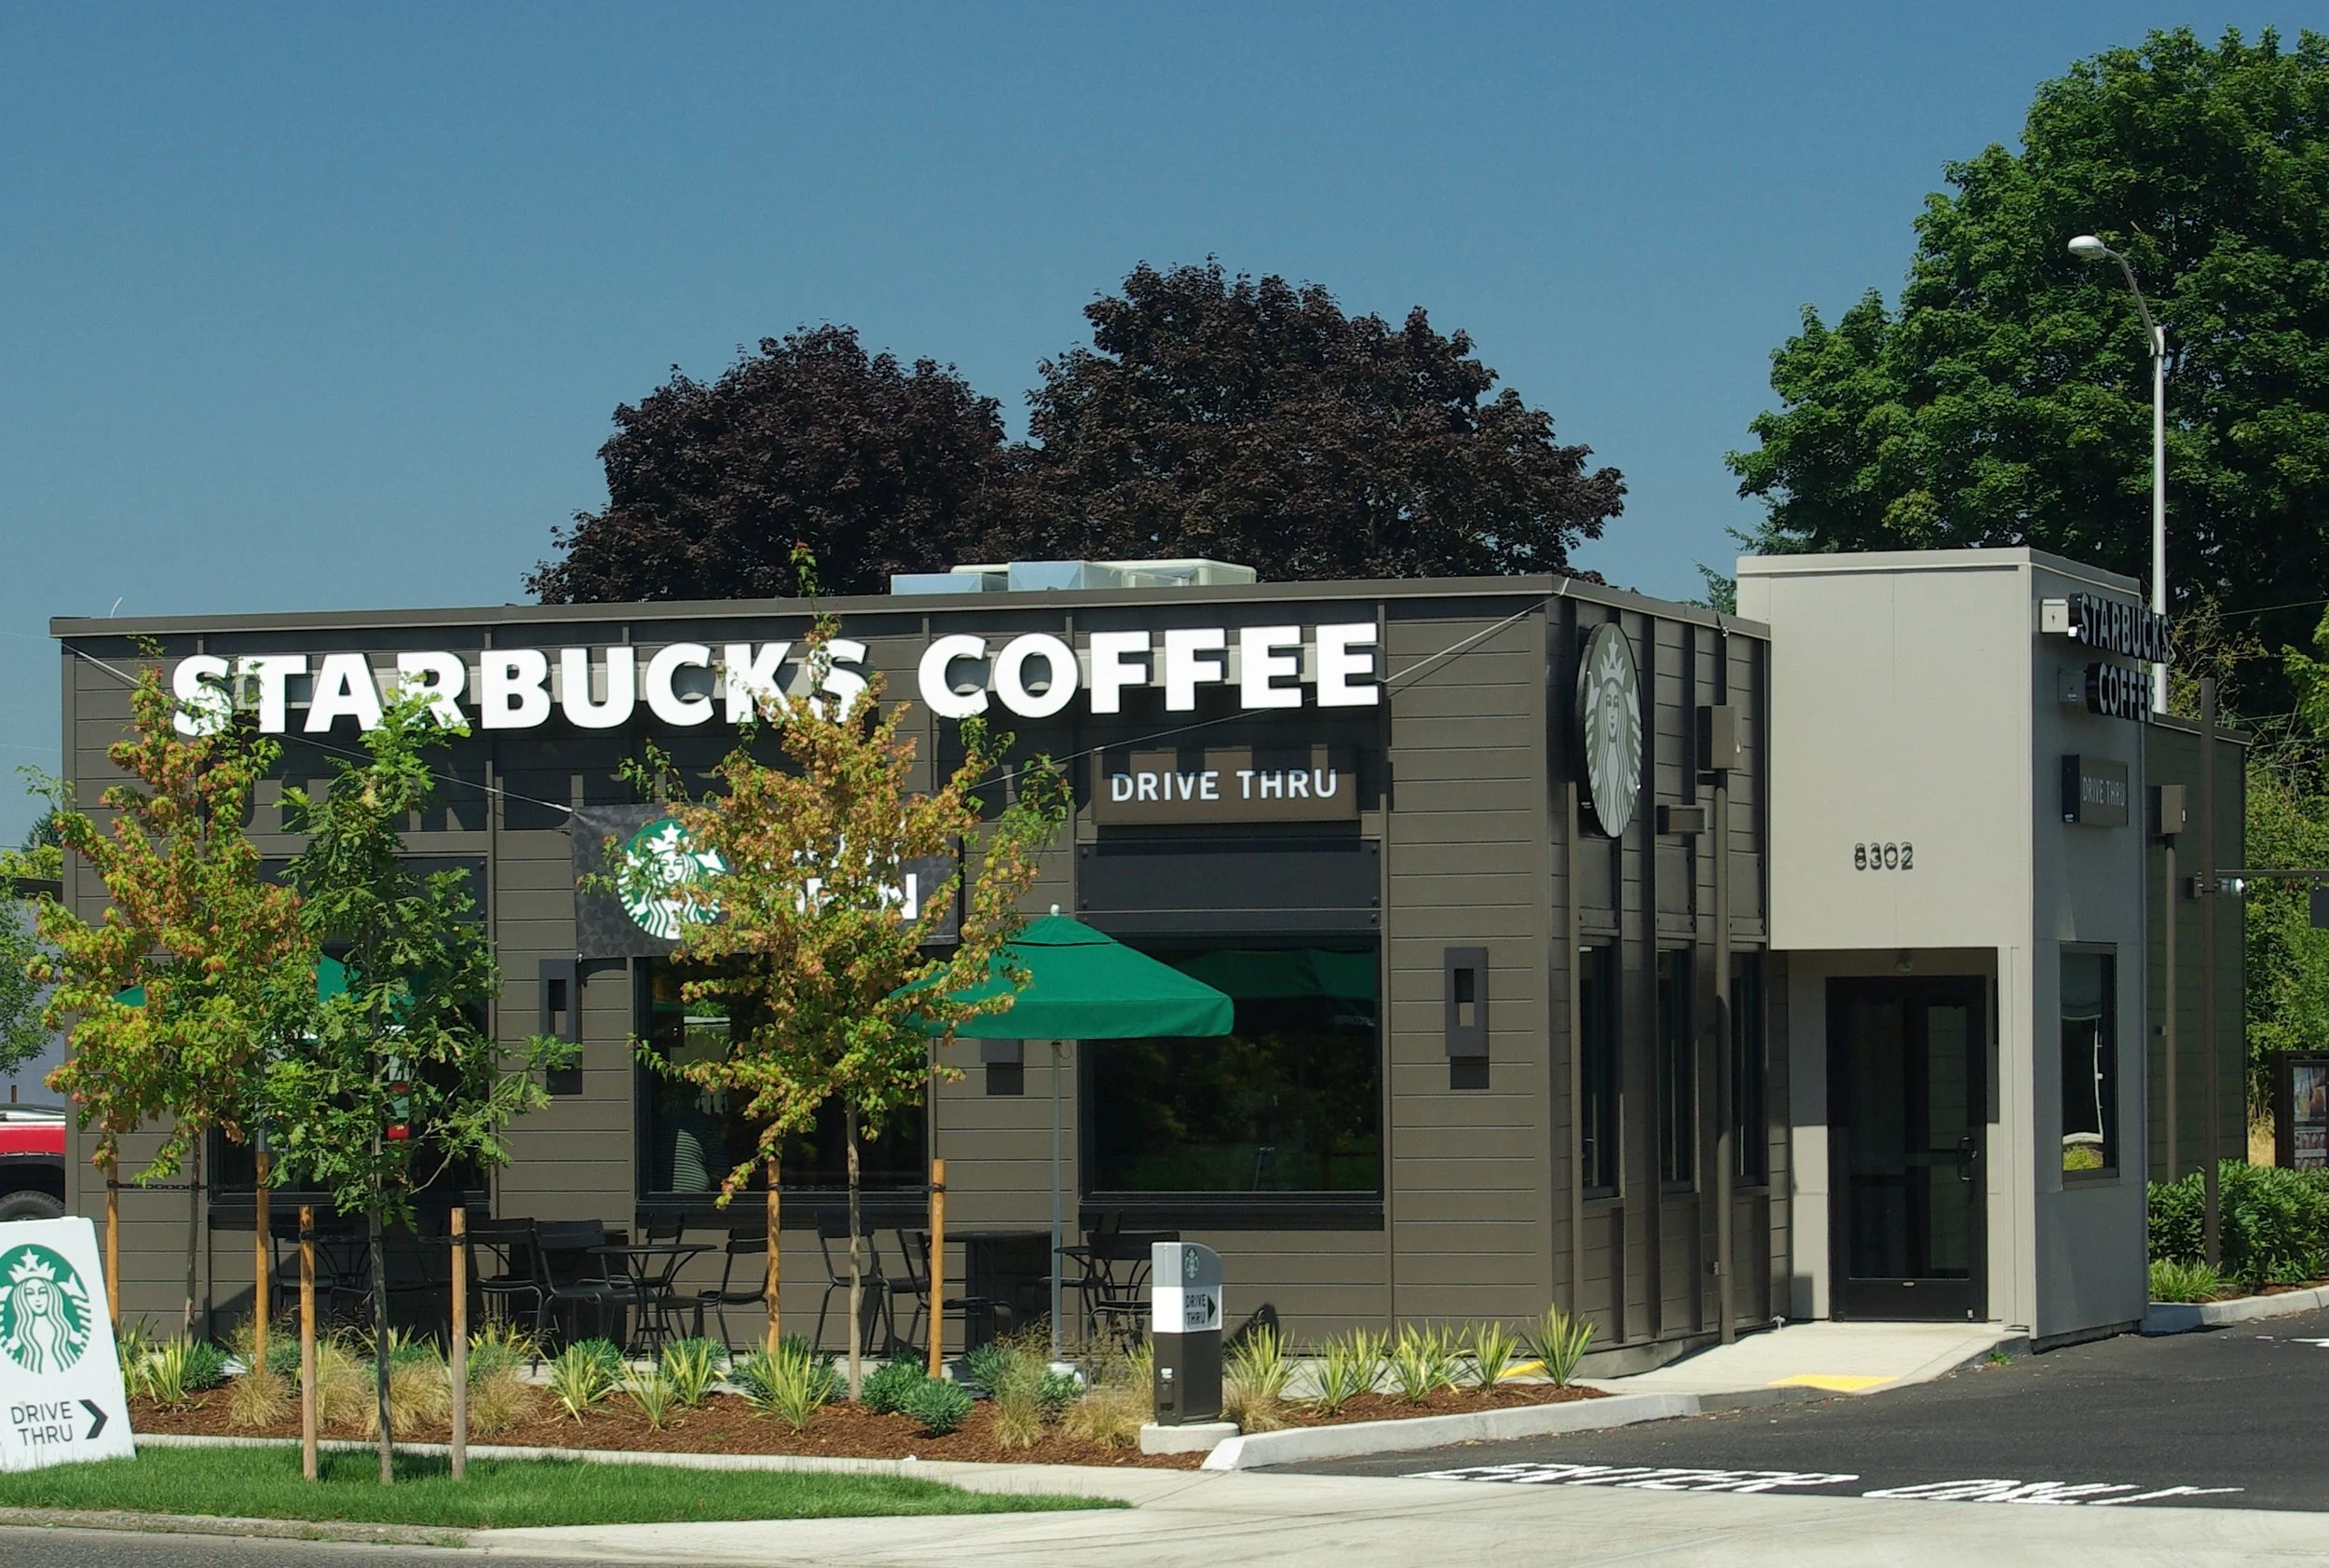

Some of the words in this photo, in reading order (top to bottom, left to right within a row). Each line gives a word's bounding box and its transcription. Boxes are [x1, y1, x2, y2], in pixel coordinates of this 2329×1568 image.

[2079, 591, 2170, 663] STARBUCKS
[172, 639, 868, 736] STARBUCKS
[918, 622, 1380, 719] COFFEE
[2098, 662, 2155, 723] COFFEE
[1111, 770, 1220, 802] DRIVE
[1235, 768, 1337, 799] THRU
[2082, 775, 2104, 804] DRIVE
[2105, 779, 2125, 808] THRU
[1854, 841, 1913, 871] 8302
[1186, 1293, 1206, 1308] DRIVE
[1186, 1312, 1206, 1326] THRU
[10, 1401, 74, 1425] DRIVE
[18, 1424, 74, 1446] THRU
[1397, 1462, 1860, 1493] ENTER
[1862, 1479, 2245, 1505] ONLY
